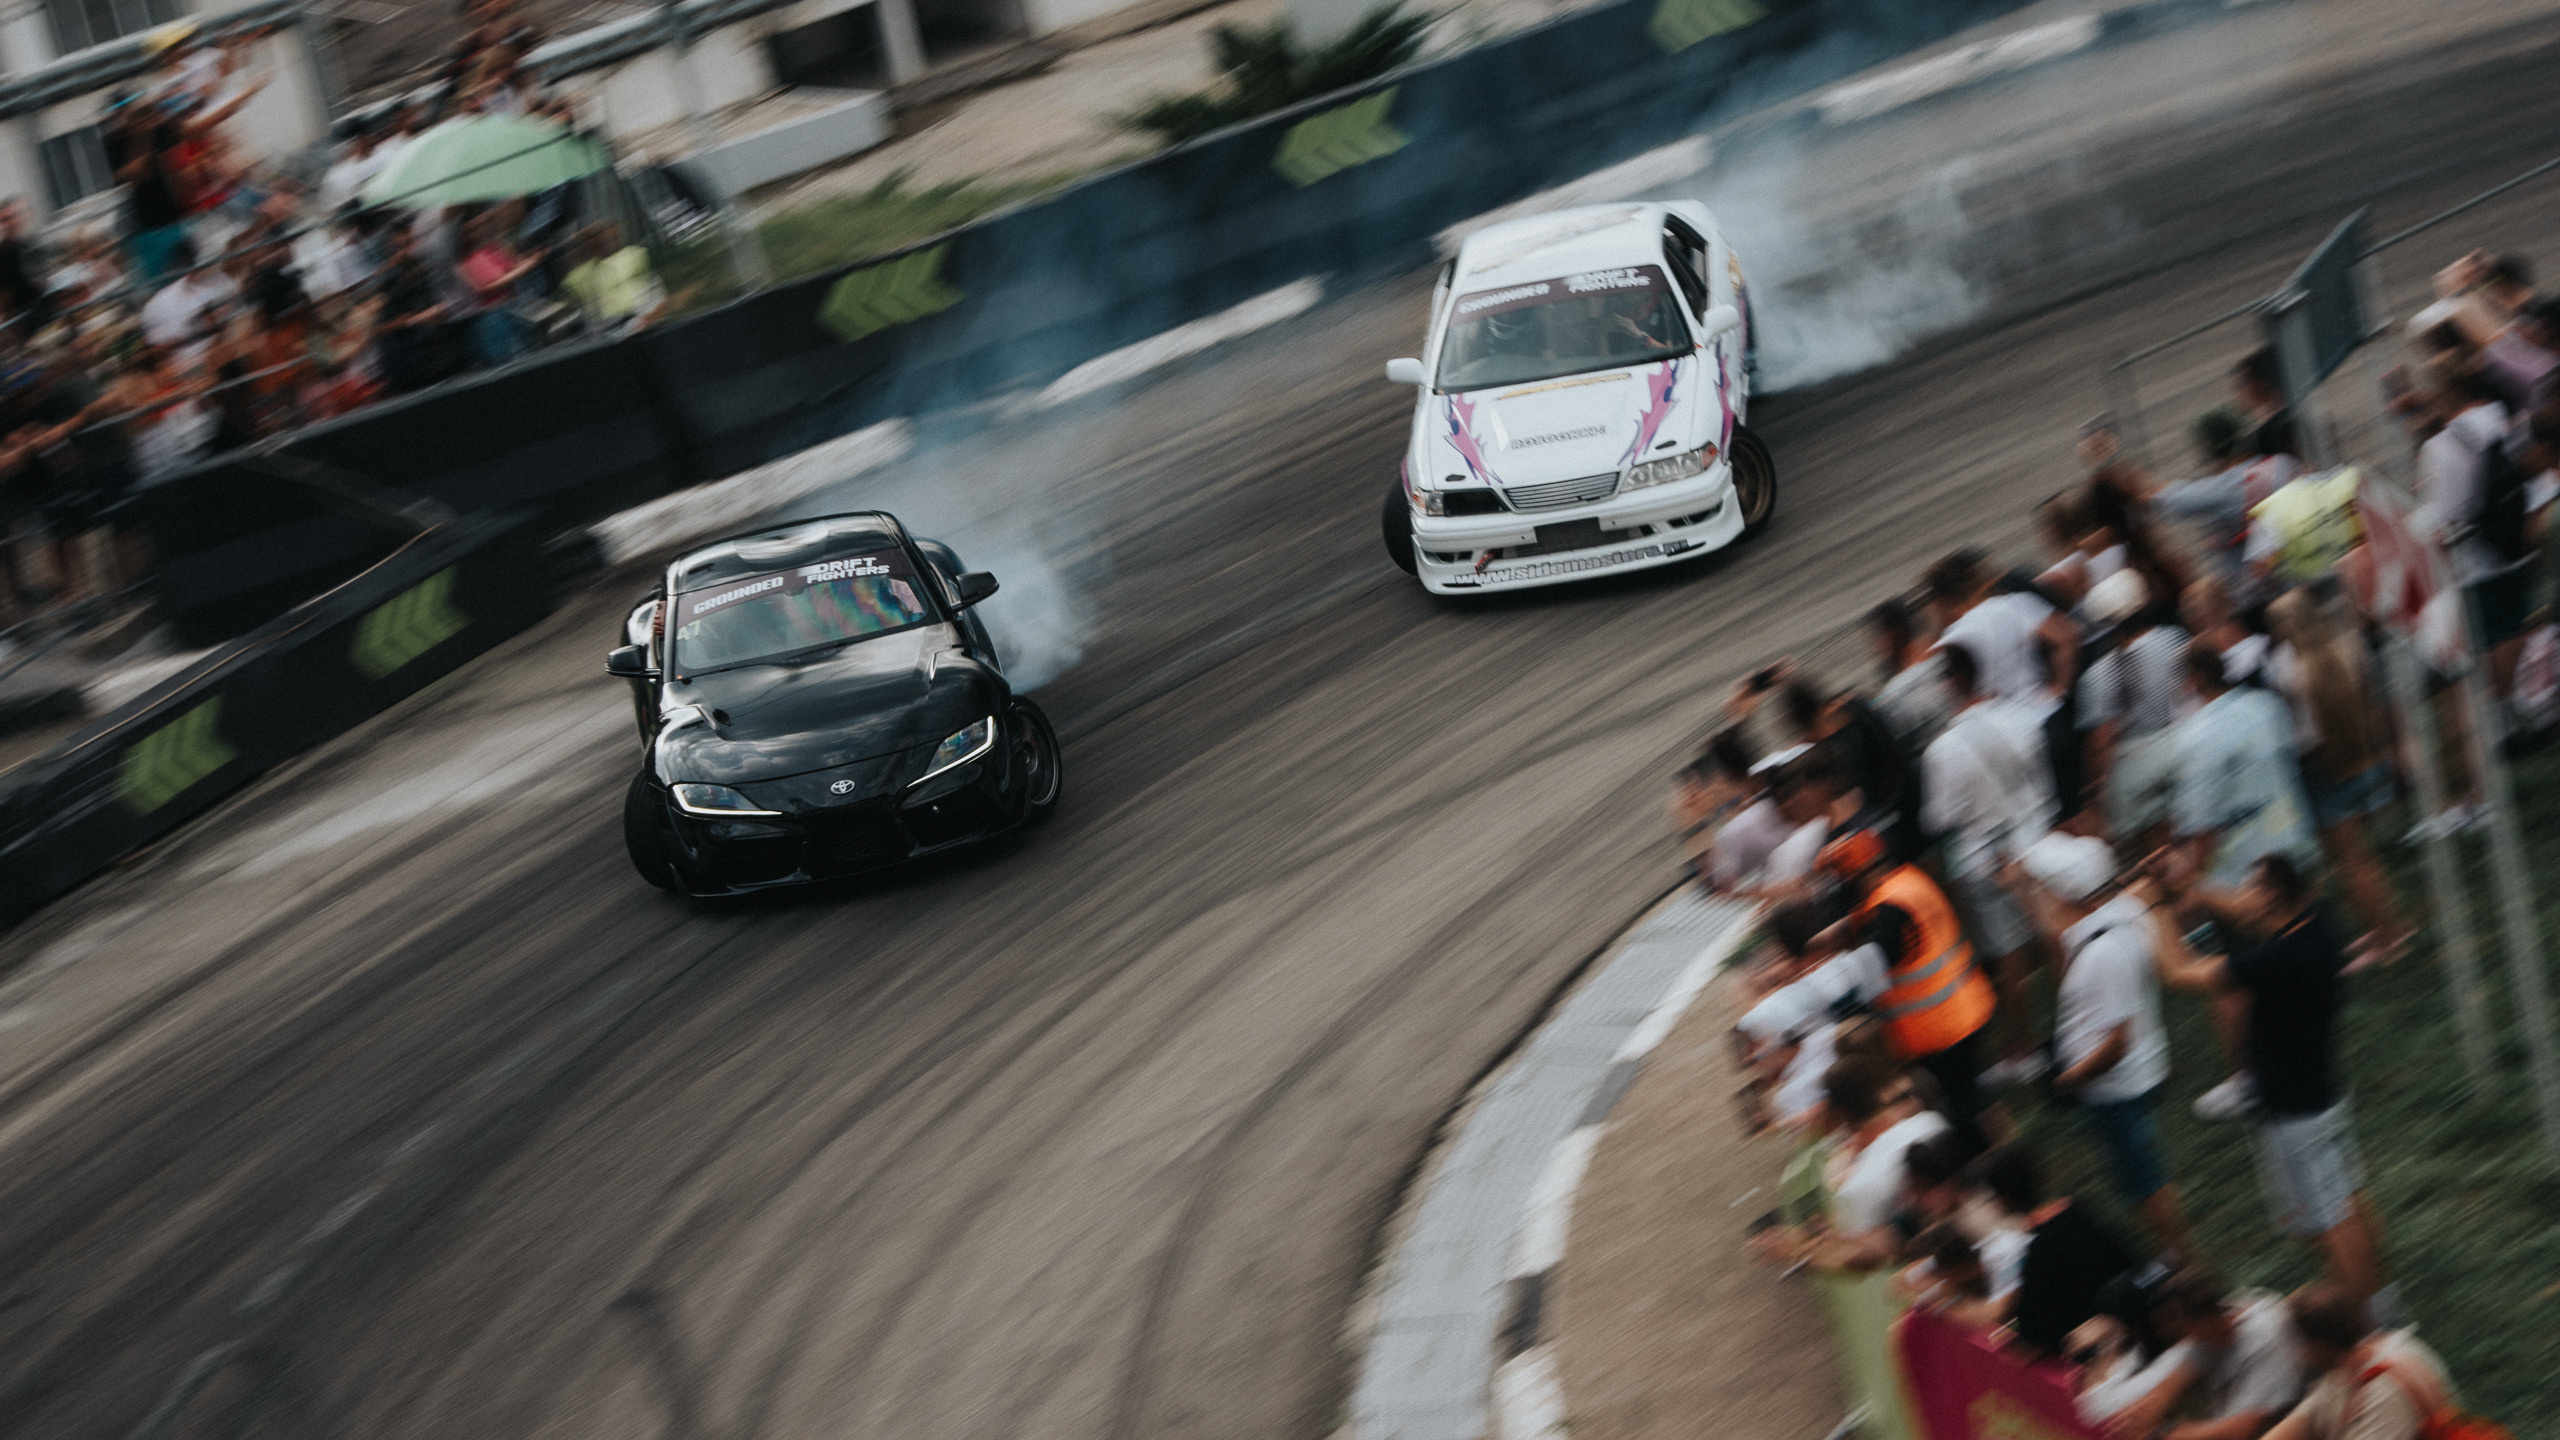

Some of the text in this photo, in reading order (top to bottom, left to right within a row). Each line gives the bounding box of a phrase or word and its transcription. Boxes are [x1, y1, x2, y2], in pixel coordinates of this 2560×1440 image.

[806, 565, 890, 585] FIGHTERS
[814, 556, 877, 574] DRIFT
[693, 576, 784, 615] GROUNDED
[676, 619, 701, 641] 47
